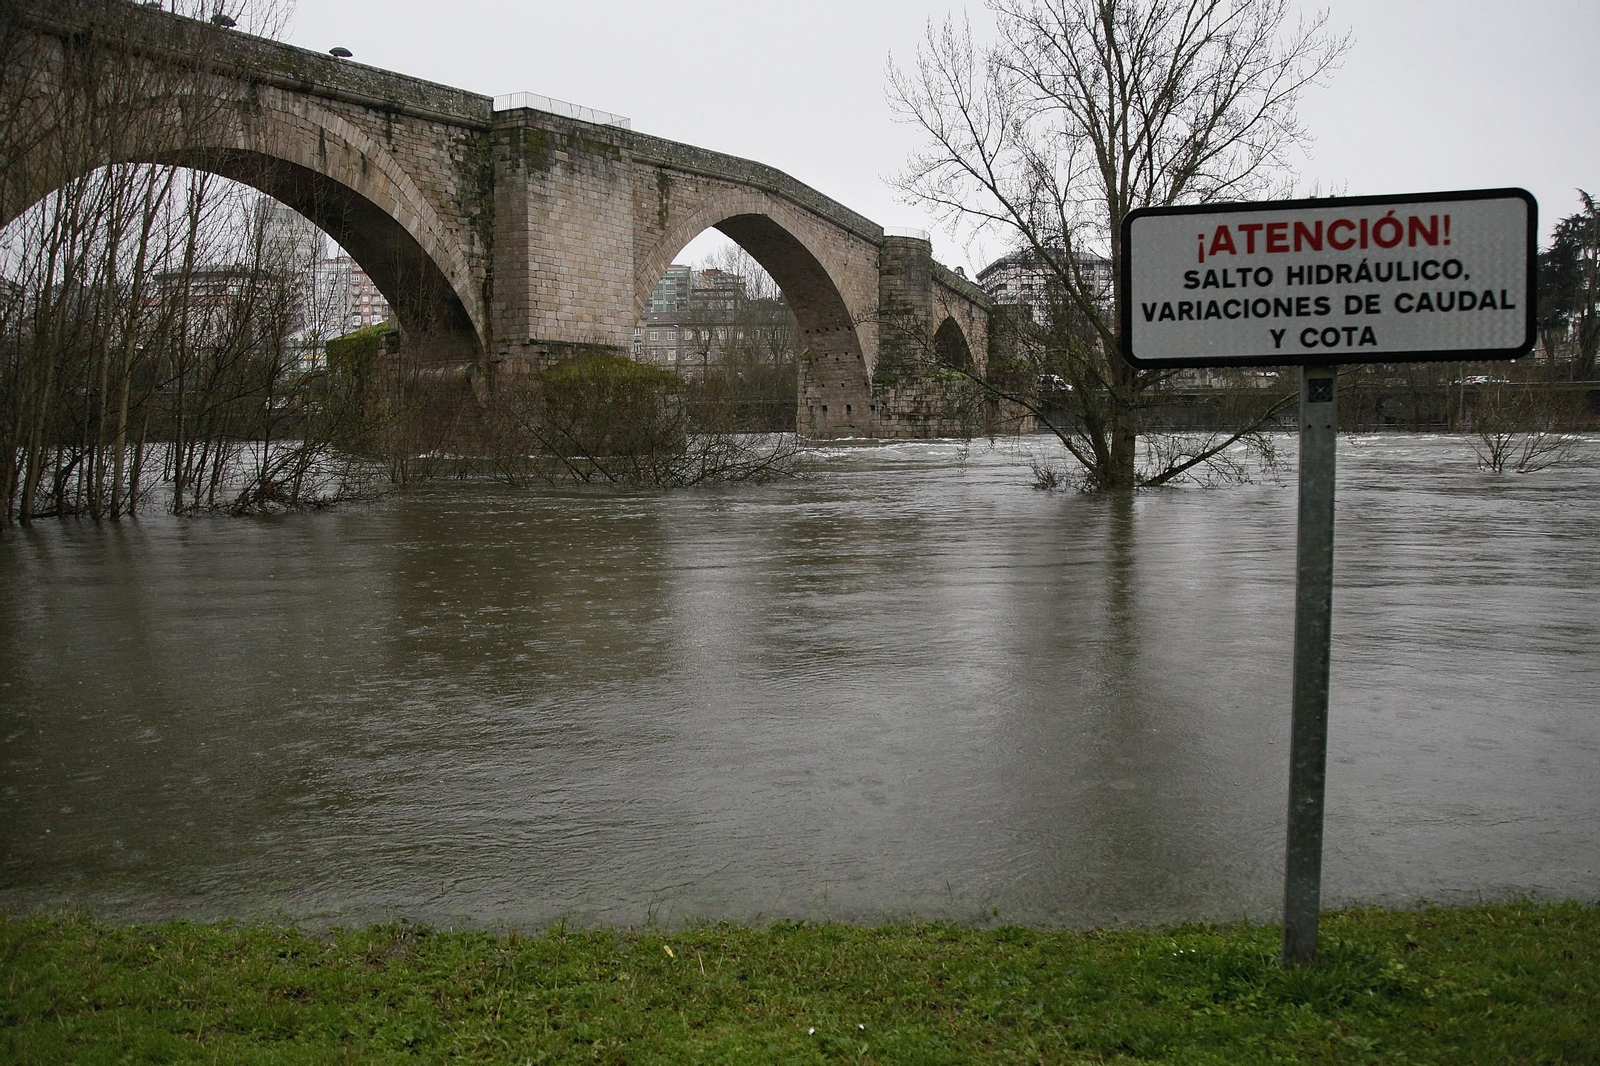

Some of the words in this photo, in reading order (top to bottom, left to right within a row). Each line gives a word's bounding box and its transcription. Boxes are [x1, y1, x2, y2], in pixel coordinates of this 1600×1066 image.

[1197, 209, 1452, 265] ¡ATENCIÓN!
[1182, 265, 1275, 290] SALTO
[1285, 257, 1471, 288] HIDRÁULICO,
[1140, 295, 1332, 323] VARIACIONES
[1343, 293, 1382, 316] DE
[1392, 288, 1517, 315] CAUDAL
[1267, 327, 1288, 350] Y
[1298, 325, 1379, 349] COTA
